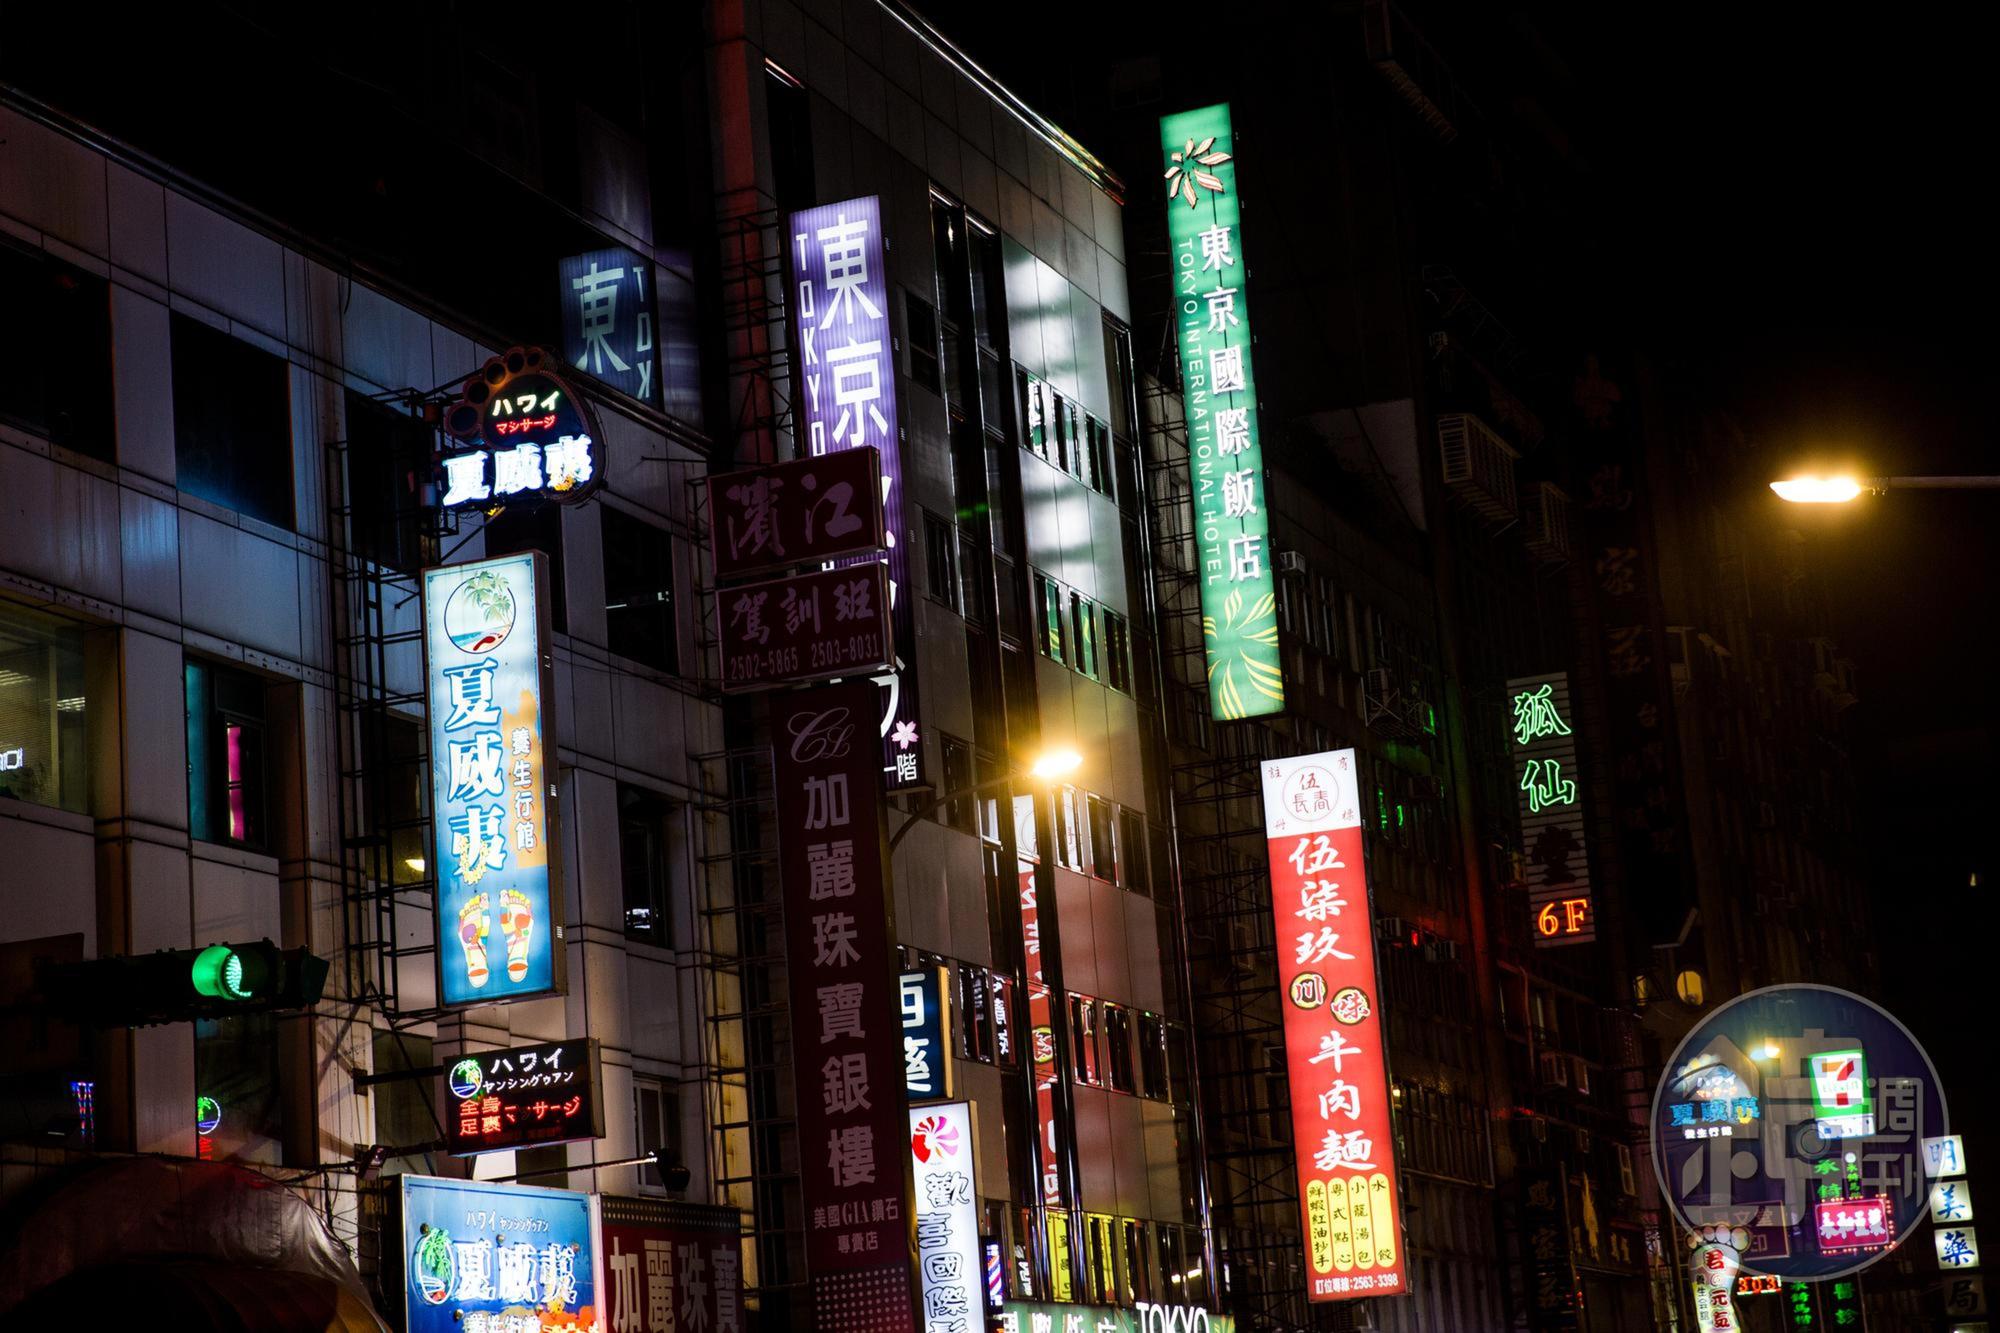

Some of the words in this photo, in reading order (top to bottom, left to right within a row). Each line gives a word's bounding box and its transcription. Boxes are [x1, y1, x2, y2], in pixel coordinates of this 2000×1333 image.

[1178, 238, 1198, 314] TOKYO
[492, 390, 560, 417] ハワイ
[1184, 320, 1215, 505] INTERNATIONAL
[1198, 223, 1263, 582] 東京國際飯店
[1202, 510, 1222, 587] HOTEL
[730, 578, 875, 645] 駕訓班
[730, 646, 799, 681] 2502-5865
[811, 632, 880, 669] 2503-8031
[443, 656, 506, 884] 夏威夷
[511, 726, 538, 852] 養生行館
[1288, 834, 1356, 965] 伍柒玖
[1538, 898, 1588, 936] 6F
[803, 772, 876, 1188] 加麗珠寶銀樓
[490, 1047, 562, 1074] ハワイ
[609, 1236, 740, 1333] 加麗珠寶
